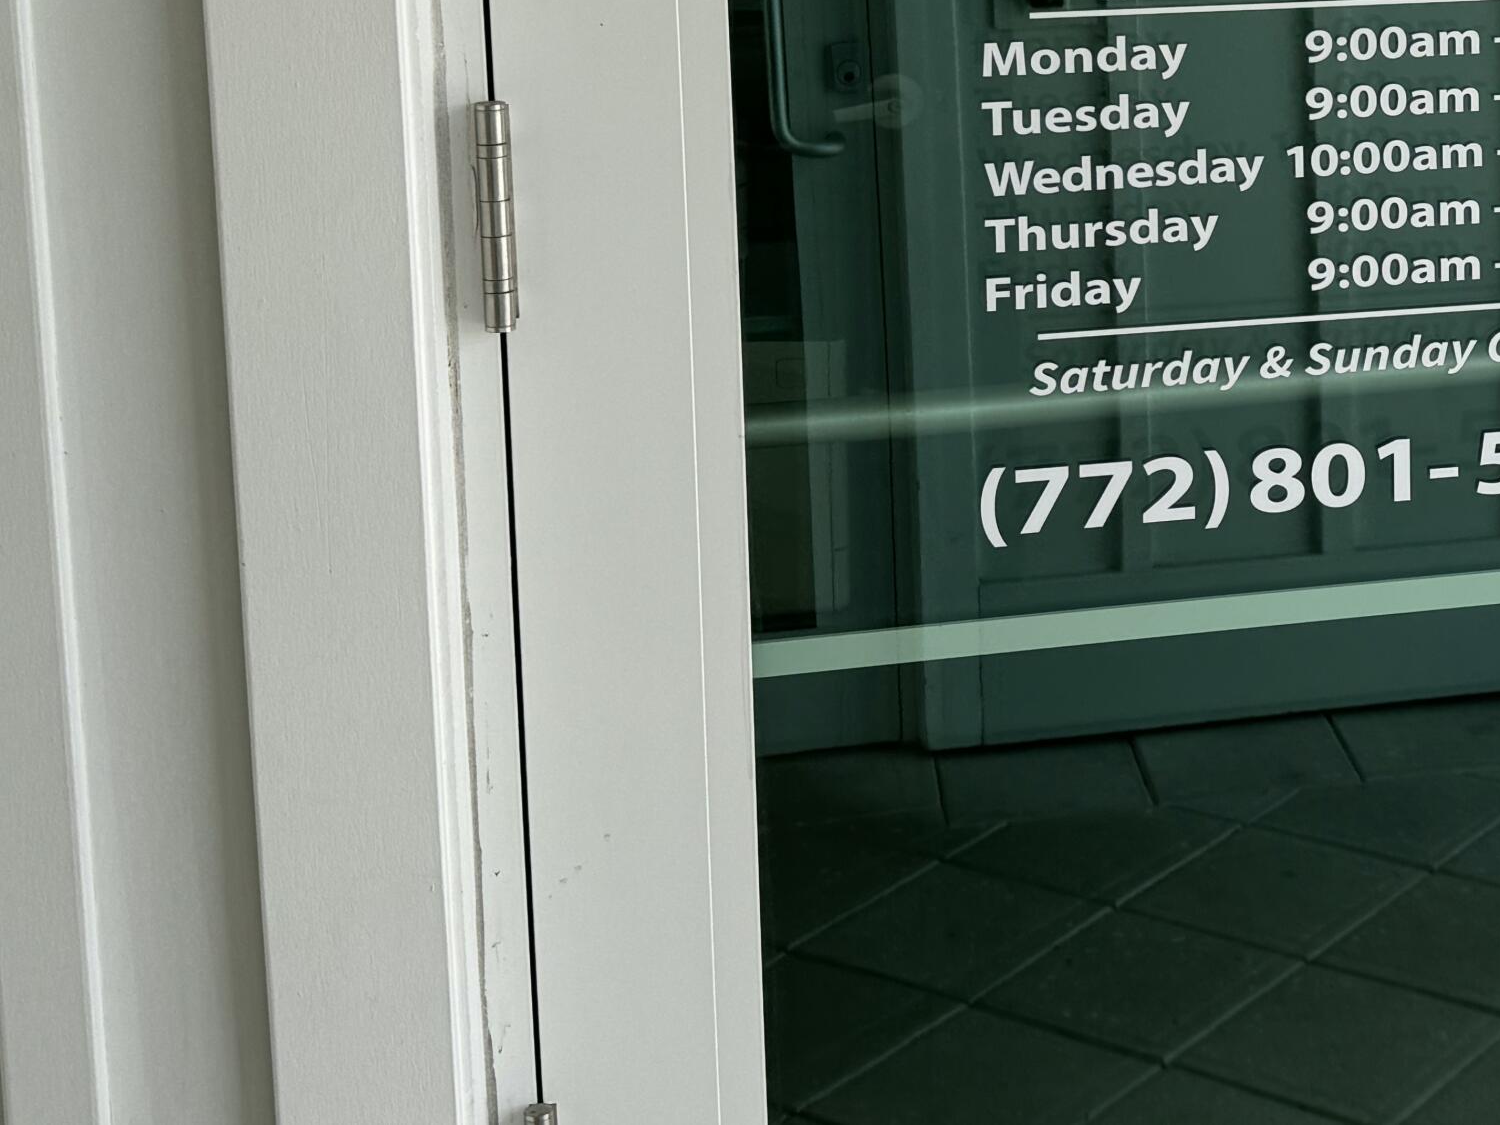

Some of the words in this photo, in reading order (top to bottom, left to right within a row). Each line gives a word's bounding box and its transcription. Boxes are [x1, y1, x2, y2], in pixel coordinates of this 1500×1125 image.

[982, 35, 1188, 80] Monday
[1305, 26, 1481, 63] 9:00am
[981, 93, 1190, 138] Tuesday
[1305, 83, 1480, 121] 9:00am
[984, 148, 1265, 197] Wednesday
[1286, 139, 1483, 178] 10:00am
[984, 208, 1219, 253] Thursday
[1306, 196, 1480, 234] 9:00am
[986, 270, 1142, 314] Friday
[1307, 253, 1481, 291] 9:00am
[1029, 350, 1251, 396] Saturday
[1259, 345, 1294, 380] &
[1304, 334, 1478, 376] Sunday
[980, 450, 1230, 548] (772)
